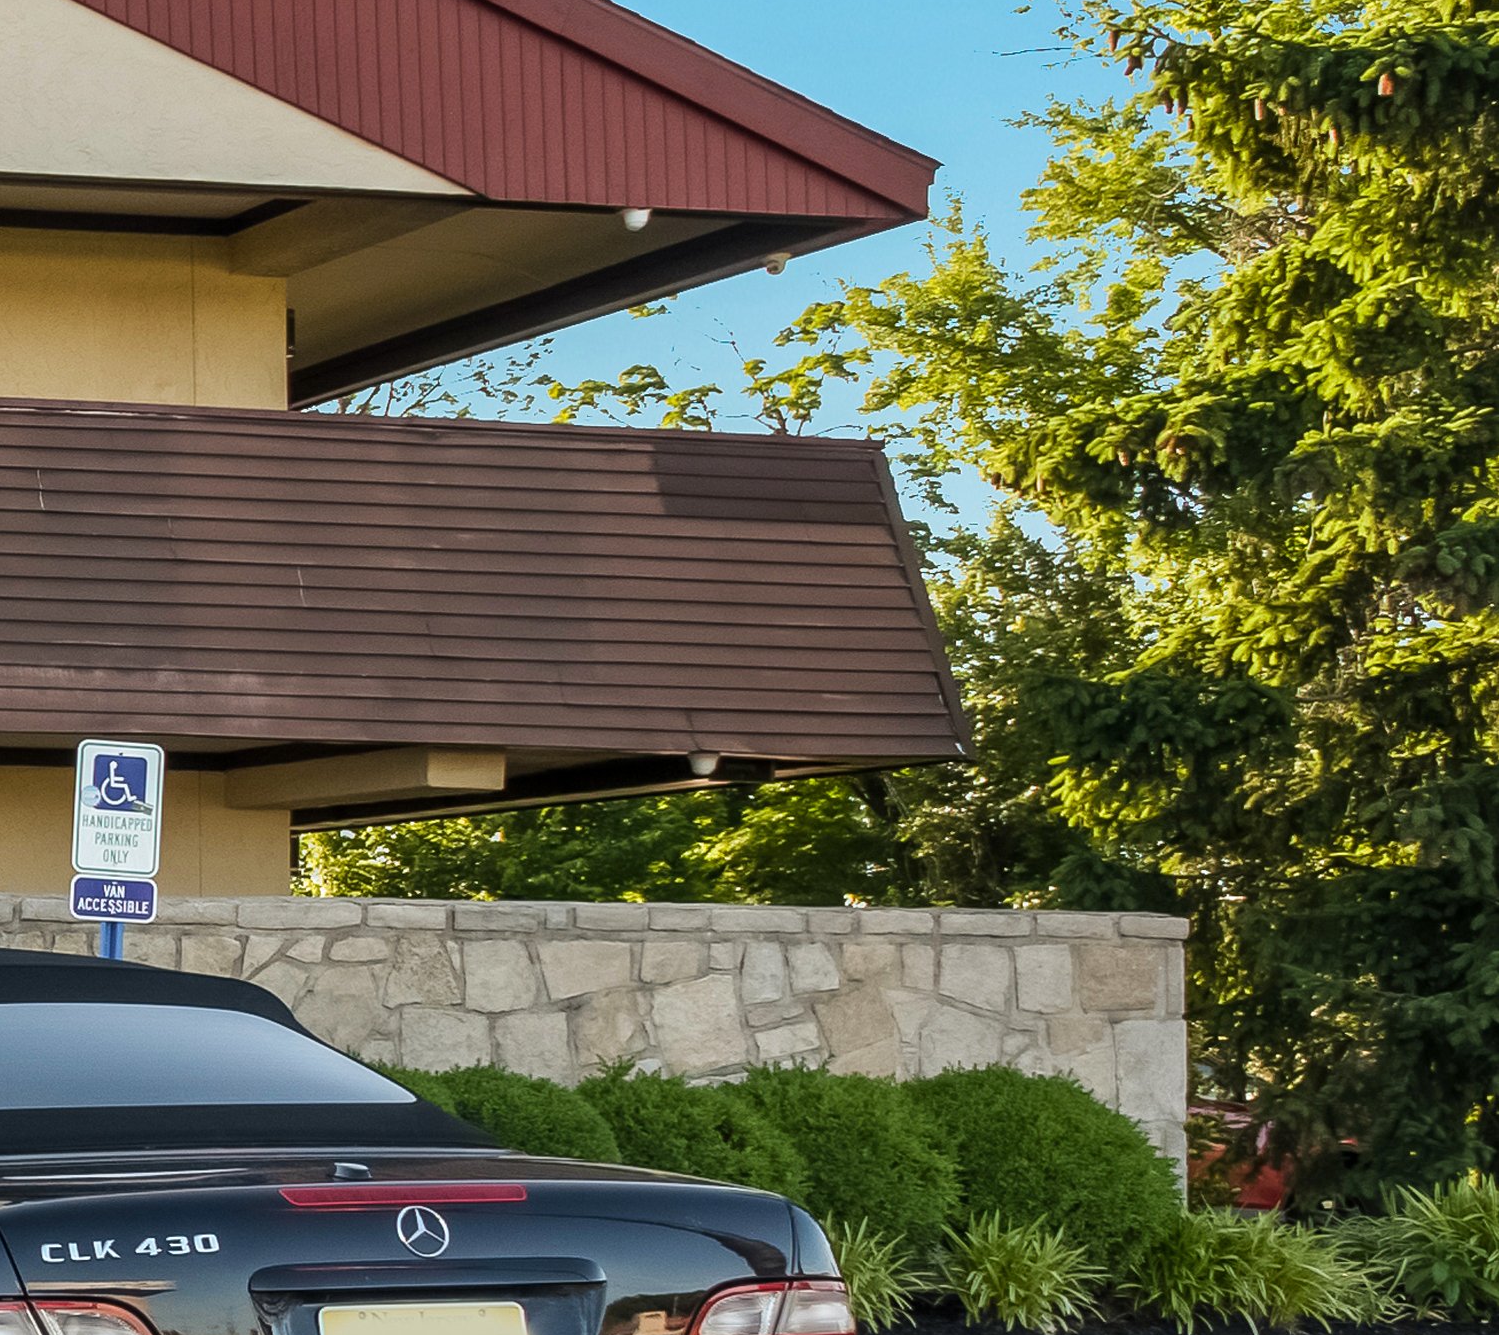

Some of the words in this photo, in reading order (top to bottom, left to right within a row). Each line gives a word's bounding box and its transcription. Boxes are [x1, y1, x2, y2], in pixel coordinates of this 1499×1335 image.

[82, 814, 152, 832] HANDICAPPED
[94, 831, 139, 848] PARKING
[102, 848, 129, 864] ONLY
[103, 884, 126, 899] VAN
[77, 896, 150, 915] ACCESSIBLE
[41, 1239, 121, 1263] CLK
[135, 1233, 219, 1256] 430
